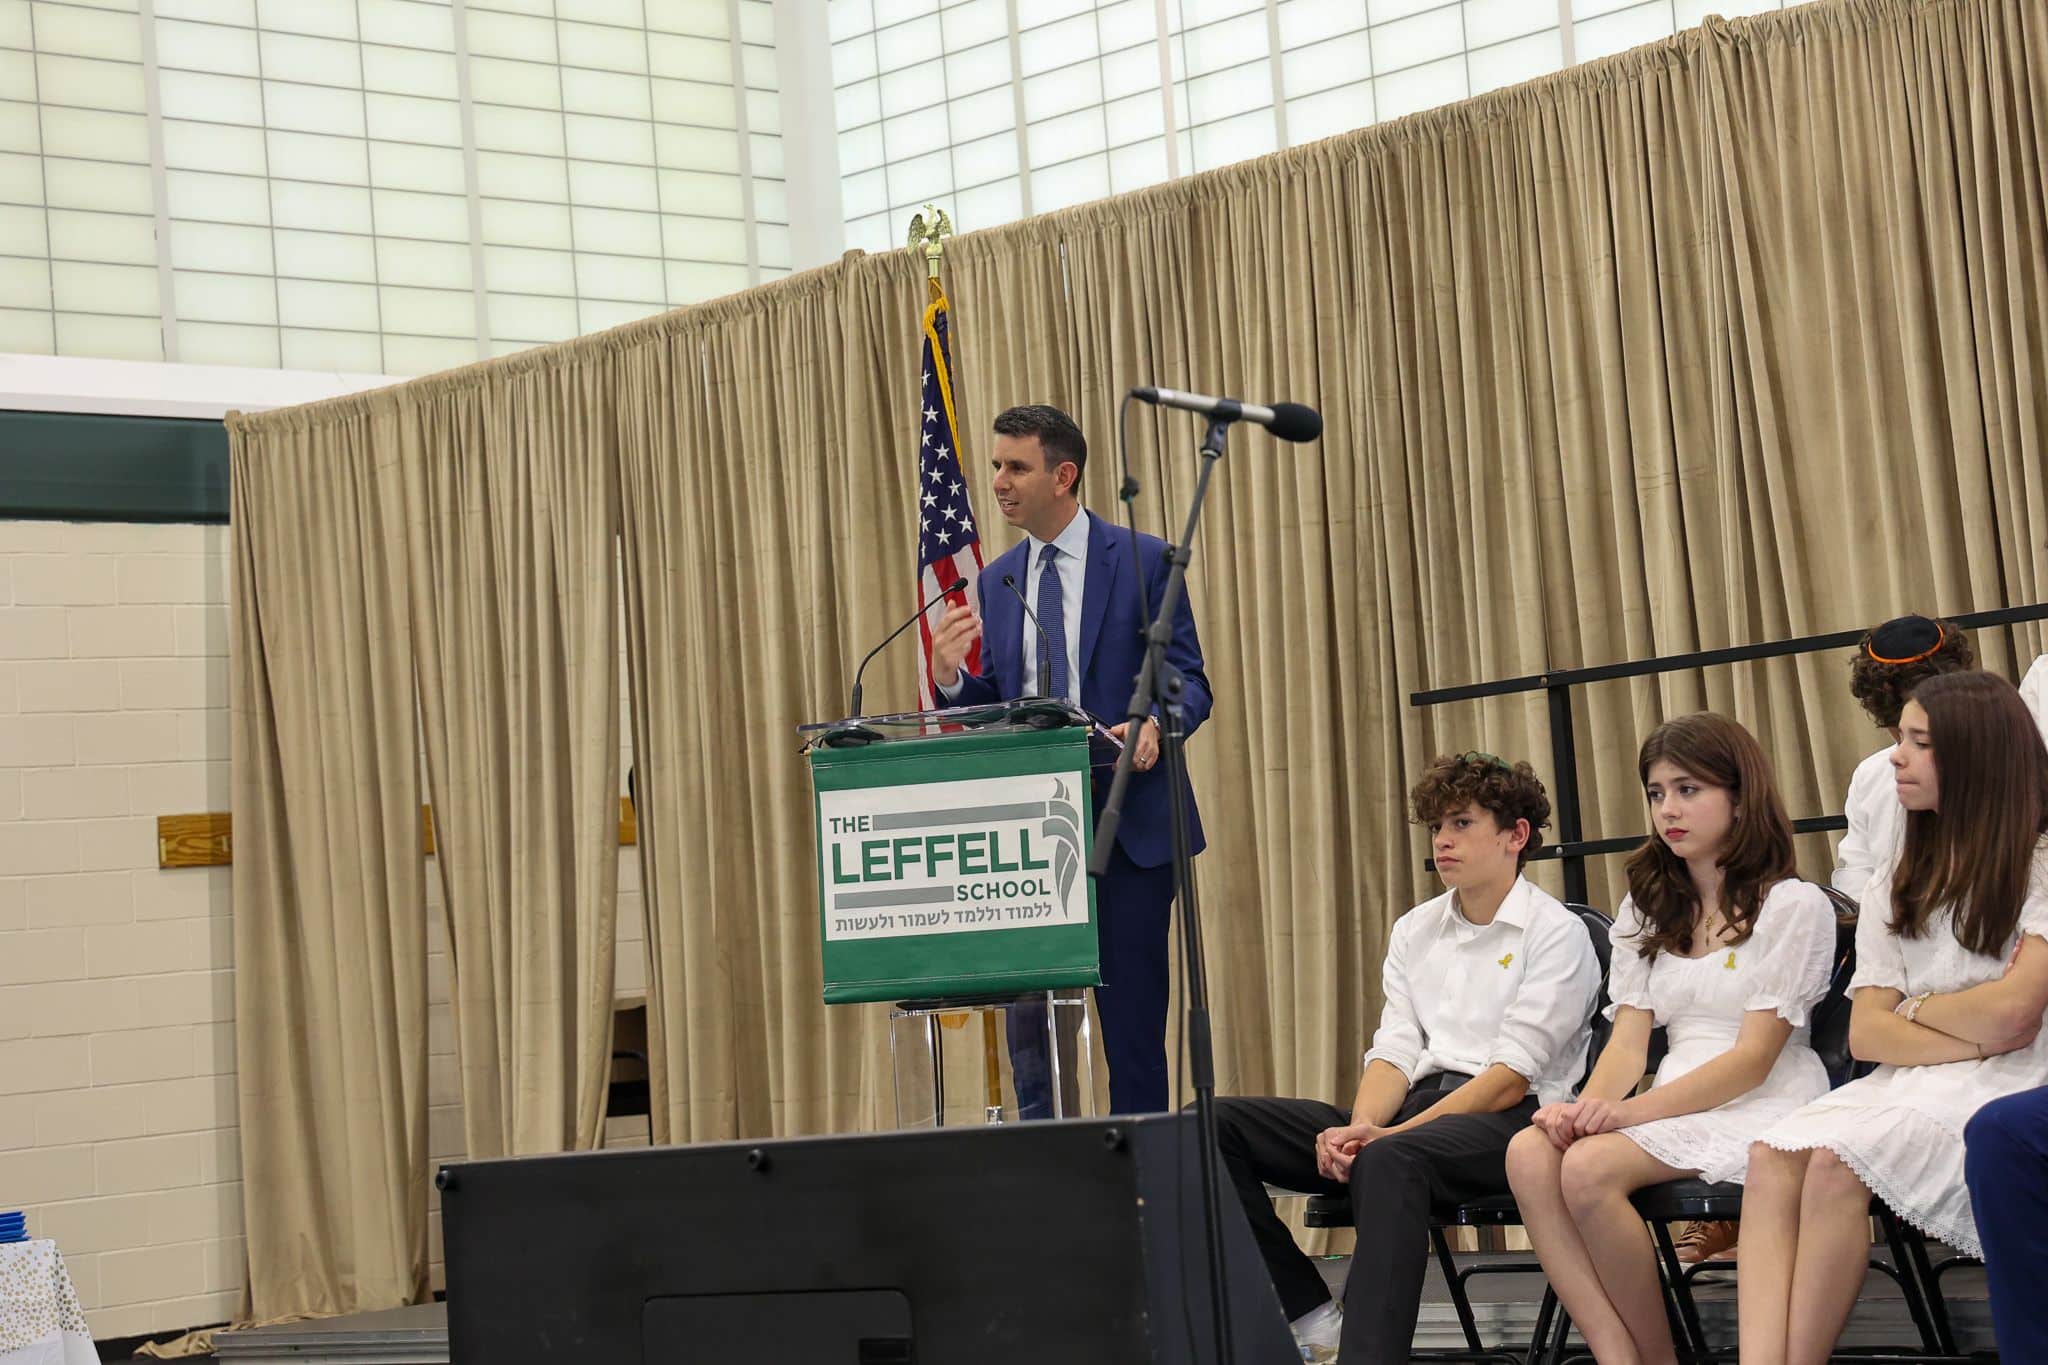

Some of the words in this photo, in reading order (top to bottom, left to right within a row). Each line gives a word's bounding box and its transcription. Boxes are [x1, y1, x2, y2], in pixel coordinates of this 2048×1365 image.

[829, 815, 870, 834] THE
[832, 828, 1049, 885] LEFFELL
[957, 878, 1051, 901] SCHOOL
[898, 909, 950, 928] לשמור
[954, 905, 1001, 923] וללמד
[1005, 903, 1052, 920] ללמוד
[835, 912, 894, 932] ולעשות
